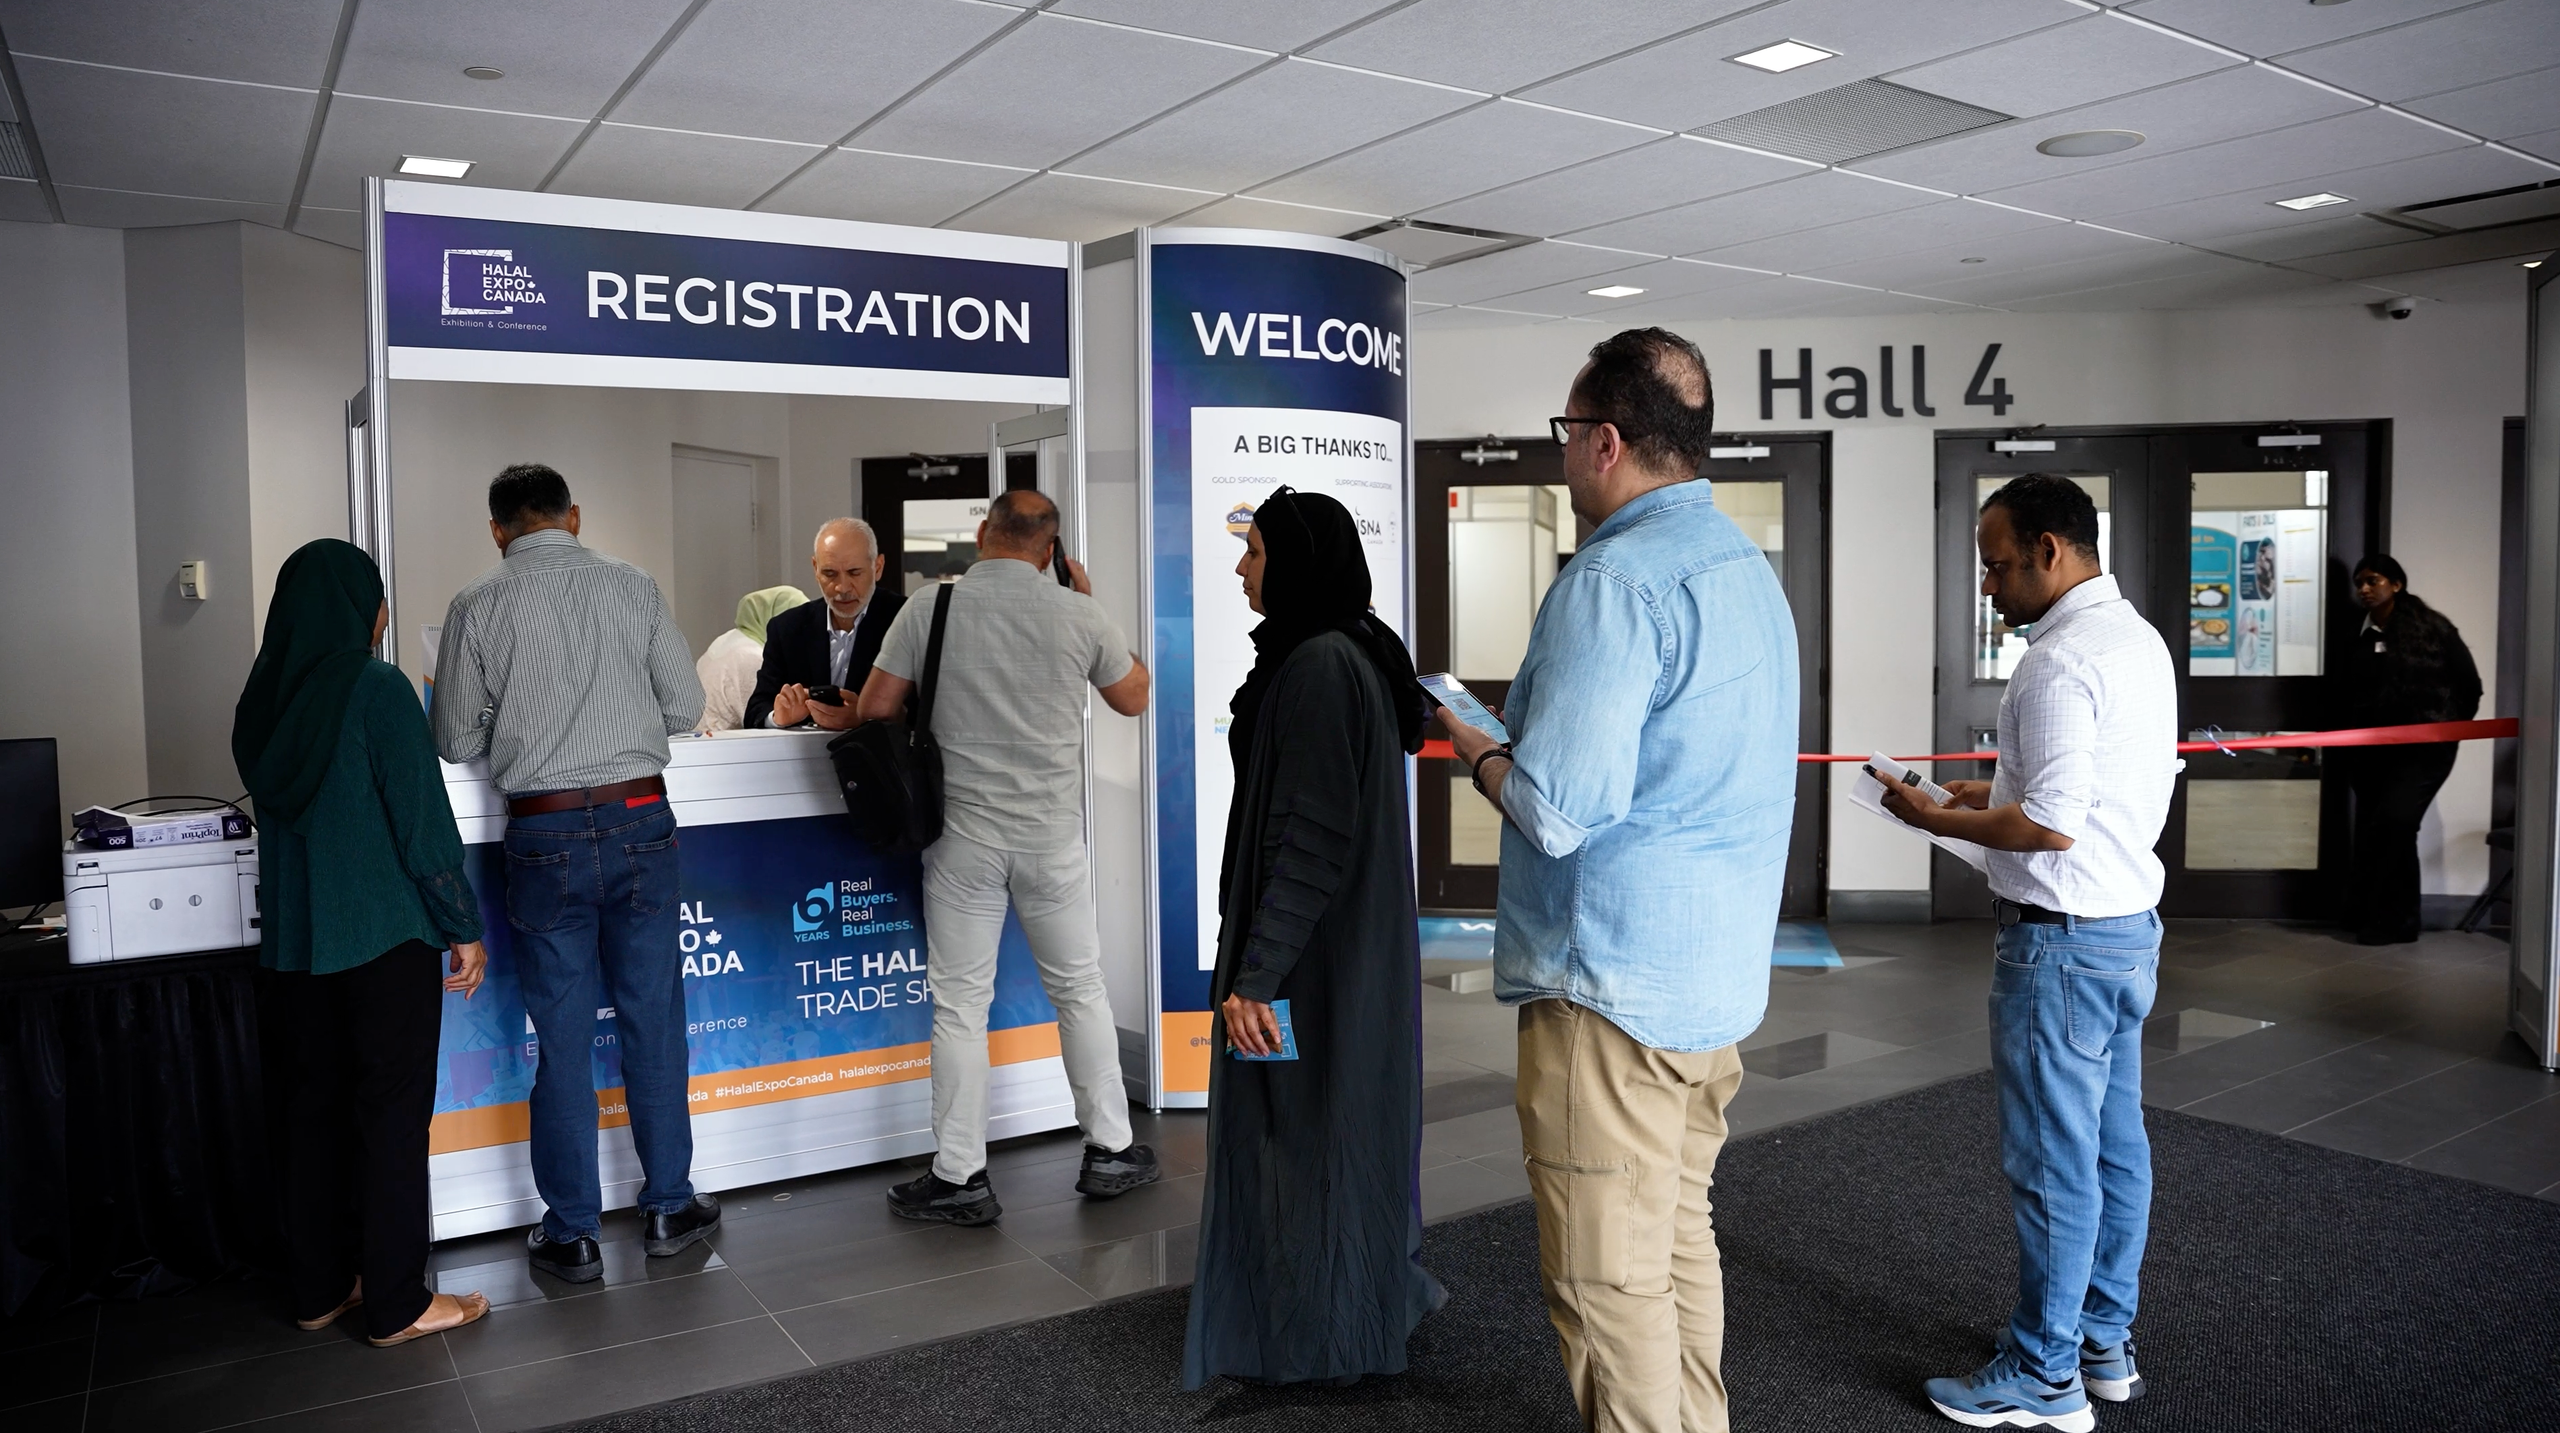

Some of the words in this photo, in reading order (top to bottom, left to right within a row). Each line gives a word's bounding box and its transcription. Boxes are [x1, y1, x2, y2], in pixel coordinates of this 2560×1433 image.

[482, 263, 532, 278] HALAL
[483, 276, 526, 290] EXPO
[483, 289, 546, 304] CANADA
[588, 271, 1029, 344] REGISTRATION
[441, 318, 484, 328] Exhibition
[487, 320, 494, 329] &
[497, 321, 547, 331] Conference
[1191, 311, 1402, 377] WELCOME
[1759, 345, 1936, 420] Hall
[1964, 343, 2014, 416] 4
[1233, 434, 1250, 453] A
[1257, 435, 1296, 454] BIG
[1301, 436, 1372, 459] THANKS
[1212, 476, 1236, 485] GOLD
[1238, 476, 1278, 485] SPONSOR
[181, 827, 223, 841] TopPrint
[841, 877, 872, 893] Real
[841, 892, 898, 909] Buyers.
[842, 907, 873, 923] Real
[794, 930, 830, 943] YEARS
[842, 920, 914, 938] Business.
[795, 956, 854, 986] THE
[796, 982, 898, 1019] TRADE
[715, 1070, 833, 1099] #HalalExpoCanada
